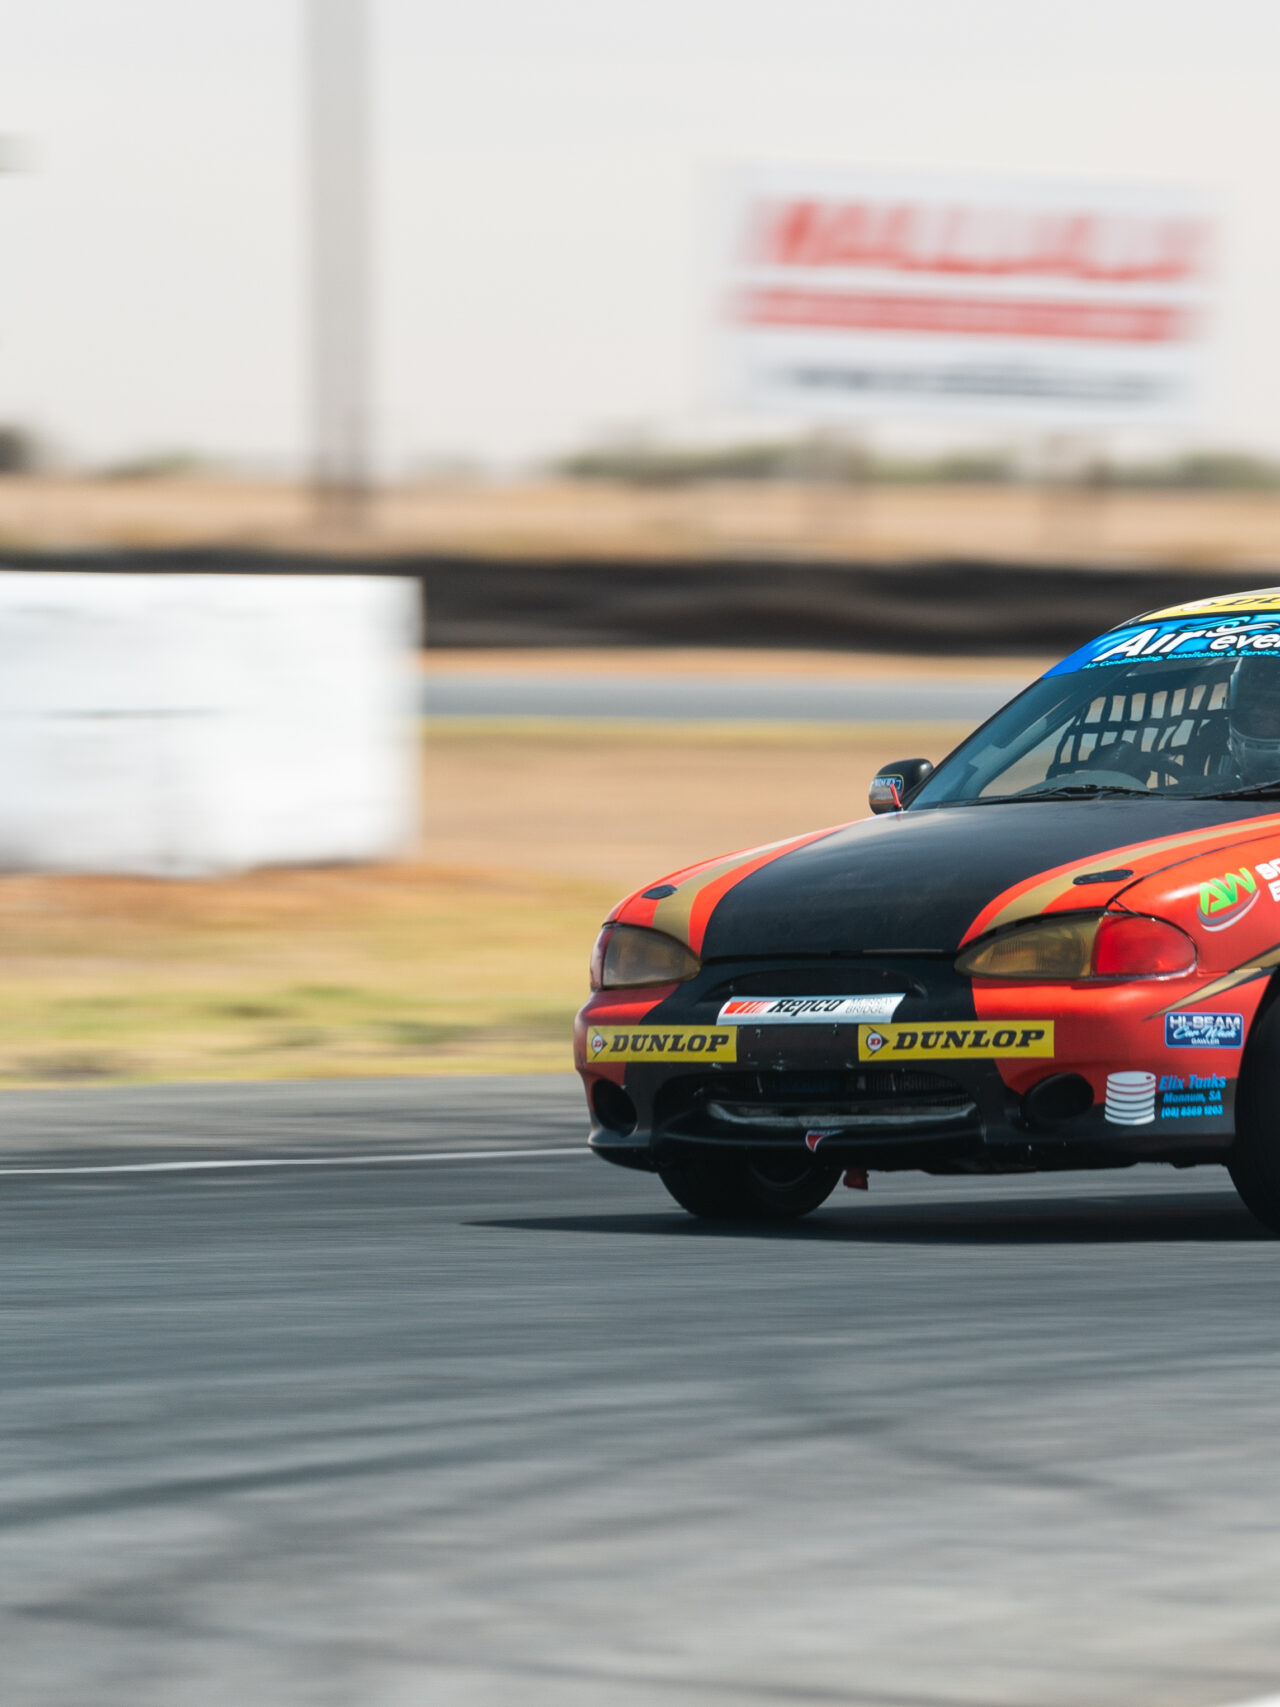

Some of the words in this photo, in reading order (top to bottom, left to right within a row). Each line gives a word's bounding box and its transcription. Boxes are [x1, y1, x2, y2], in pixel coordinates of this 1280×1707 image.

[1092, 628, 1205, 662] Air
[1167, 650, 1225, 660] Installation
[1239, 649, 1280, 657] Service
[767, 1000, 846, 1016] Repco
[1169, 1015, 1240, 1029] HI-BEAM
[609, 1034, 729, 1054] DUNLOP
[892, 1029, 1045, 1049] DUNLOP
[1159, 1075, 1184, 1090] Elix
[1189, 1072, 1226, 1089] Tanks
[1209, 1090, 1222, 1101] SA
